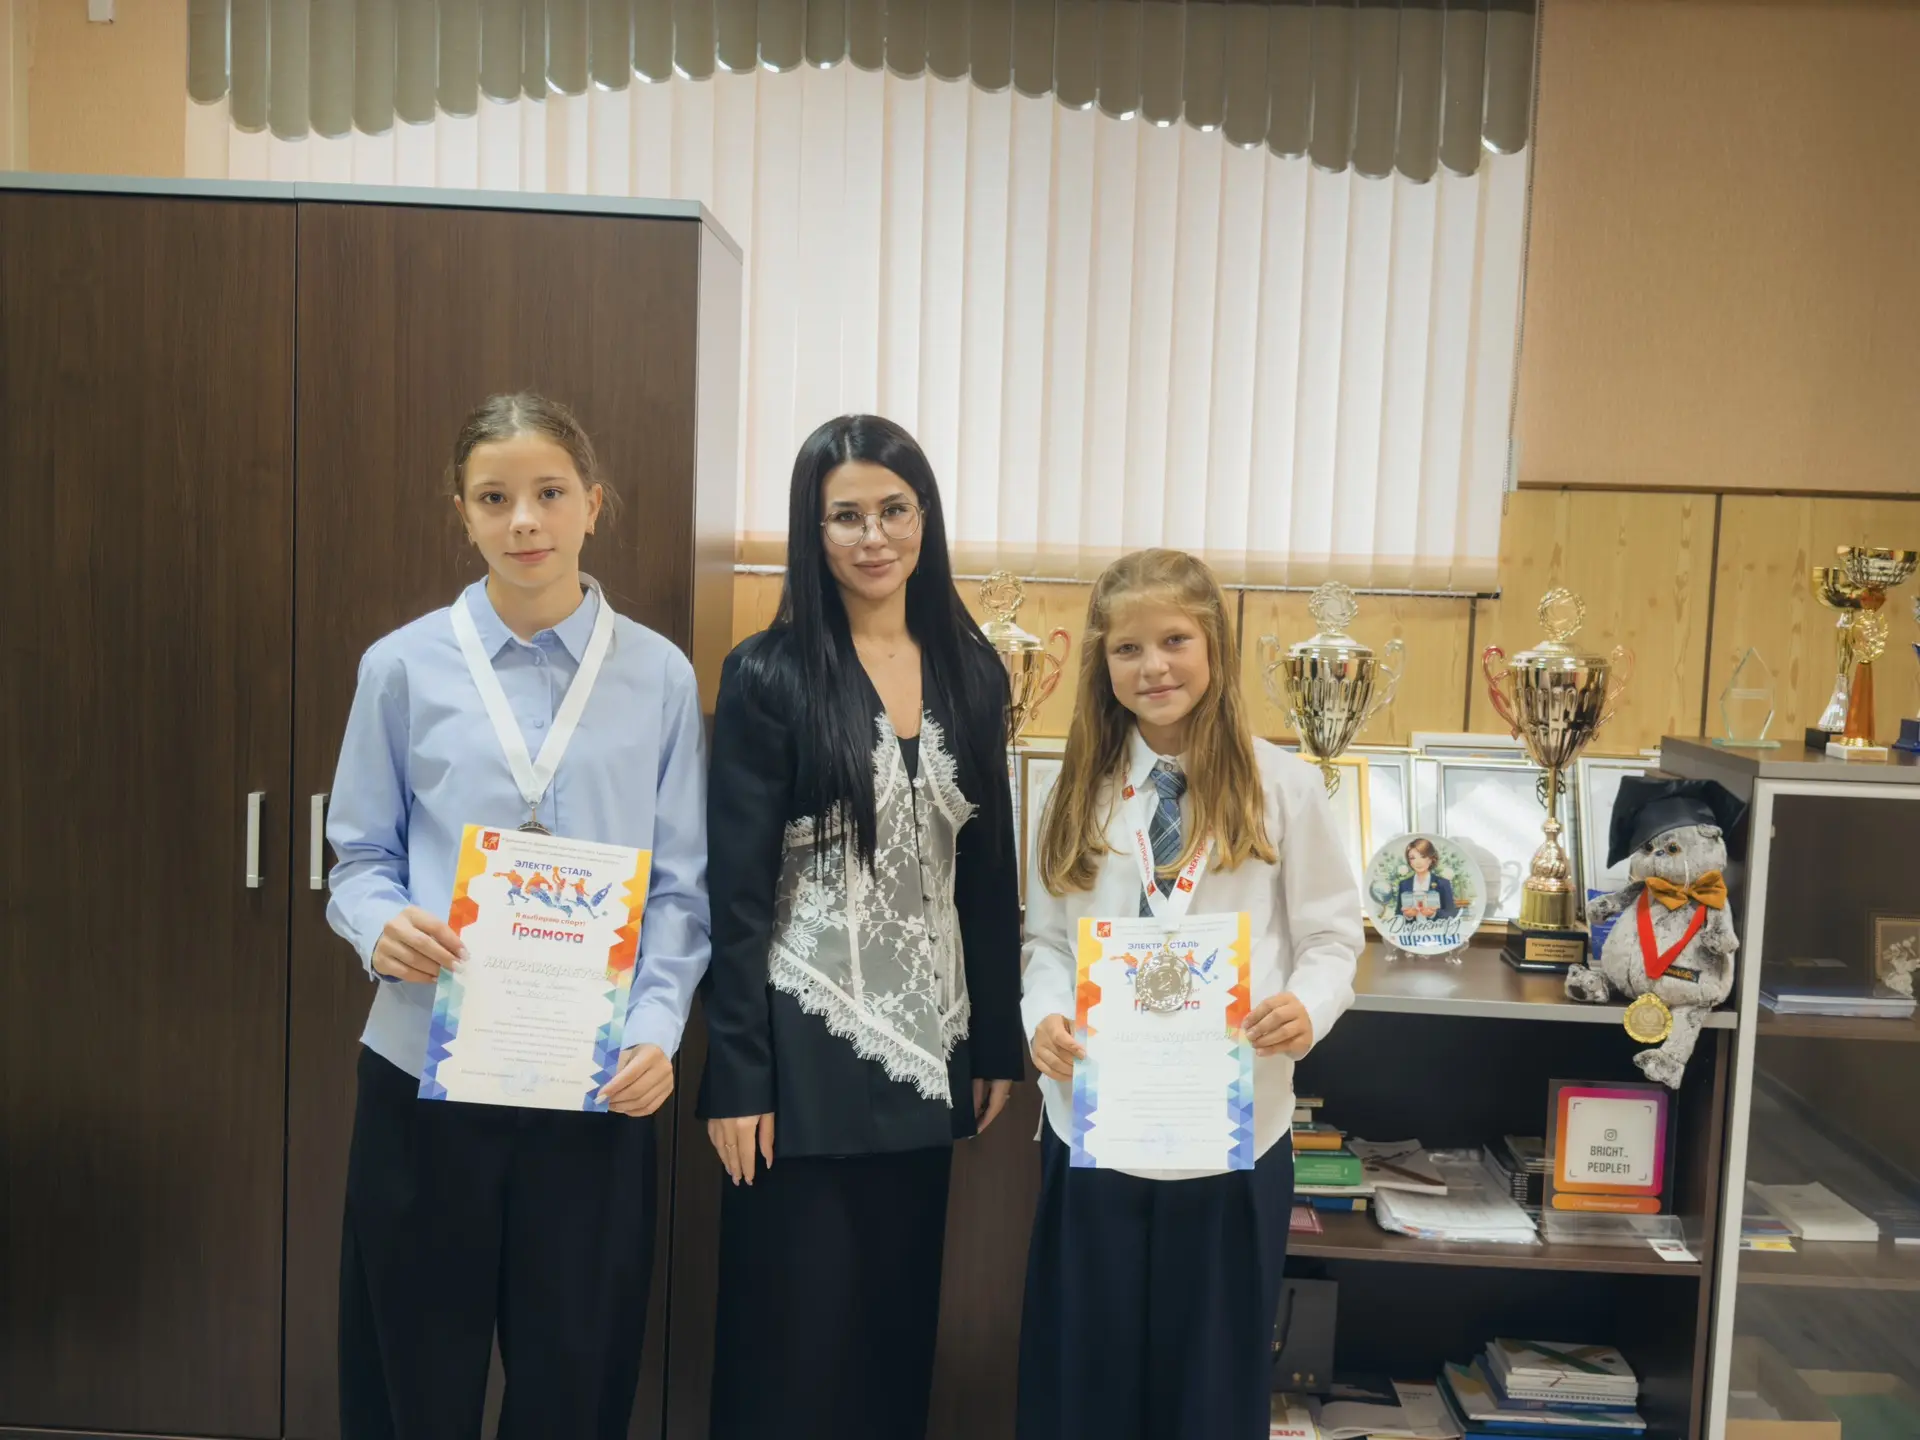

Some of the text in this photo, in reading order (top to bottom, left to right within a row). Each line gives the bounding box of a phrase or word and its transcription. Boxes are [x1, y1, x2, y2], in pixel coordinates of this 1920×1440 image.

[522, 913, 560, 923] выбираю
[512, 922, 584, 944] Грамота
[1587, 1161, 1630, 1174] PEOPLE11
